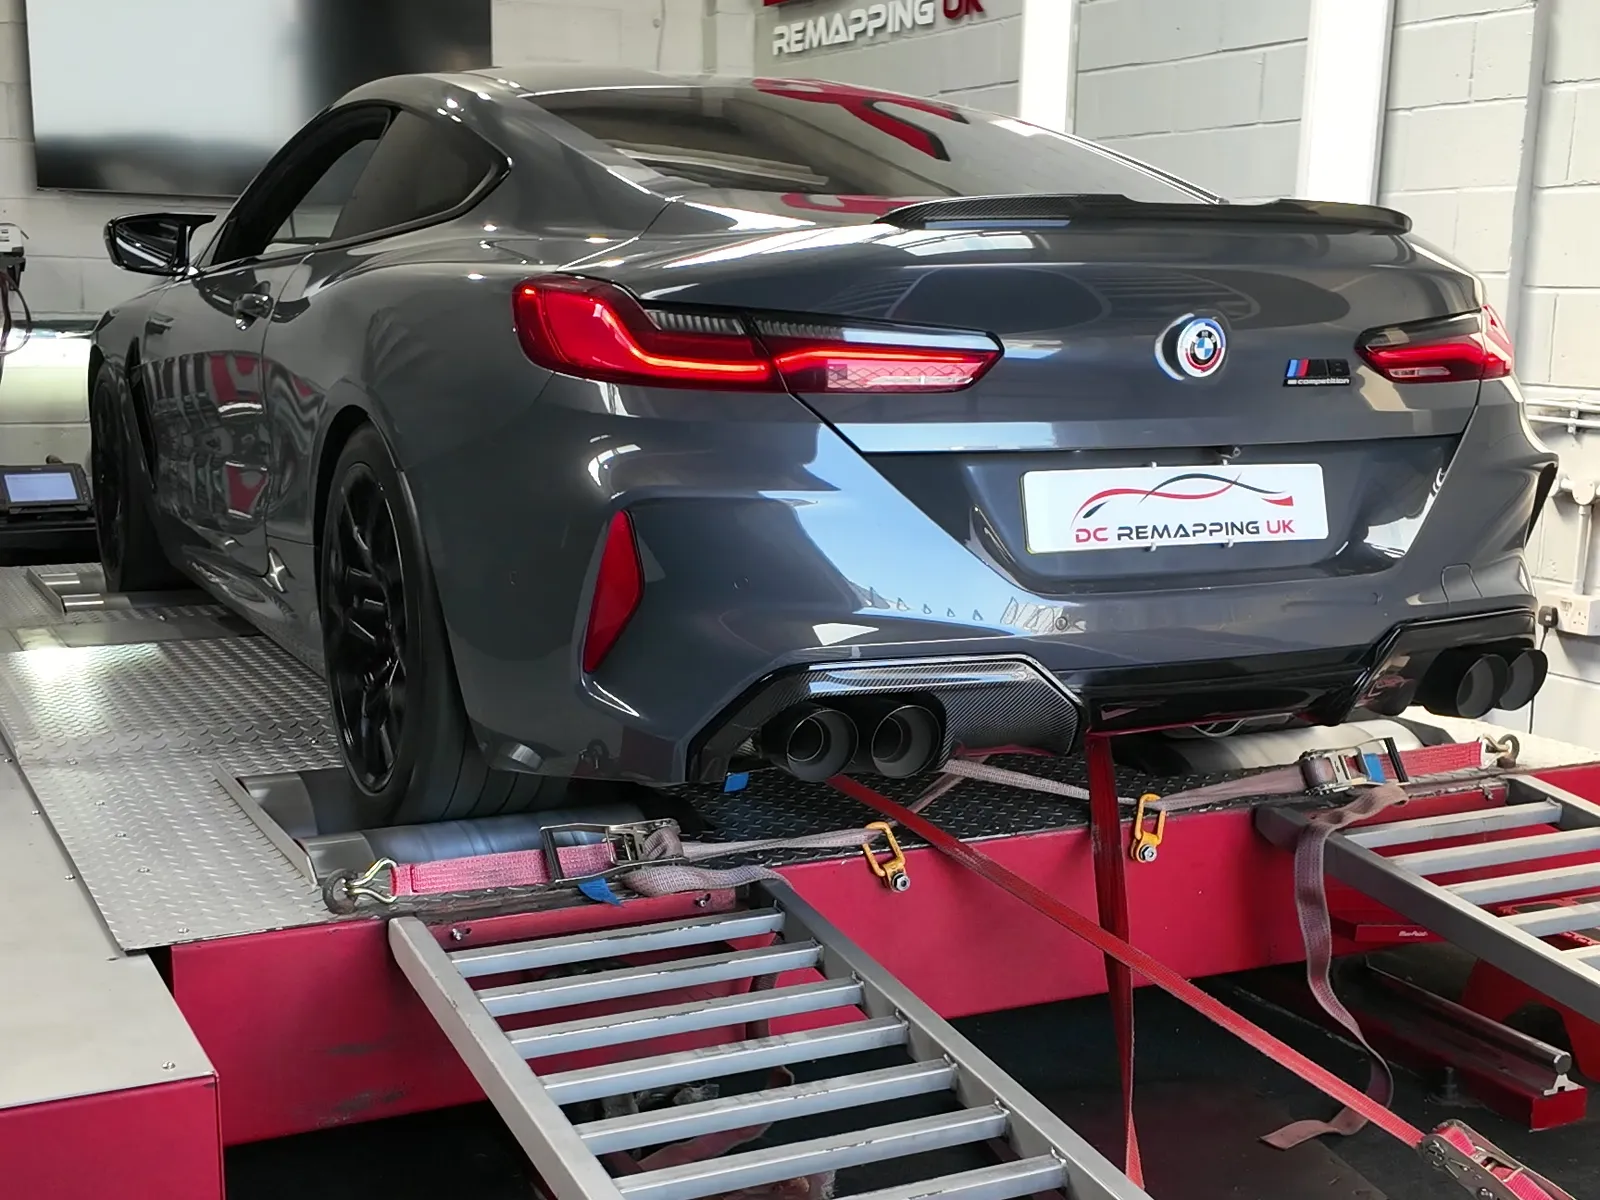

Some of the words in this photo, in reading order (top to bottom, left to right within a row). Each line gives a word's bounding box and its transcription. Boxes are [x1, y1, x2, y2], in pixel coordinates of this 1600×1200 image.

[772, 0, 934, 55] REMAPPING
[1075, 527, 1109, 543] DC
[1117, 520, 1260, 541] REMAPPING
[1265, 519, 1295, 534] UK
